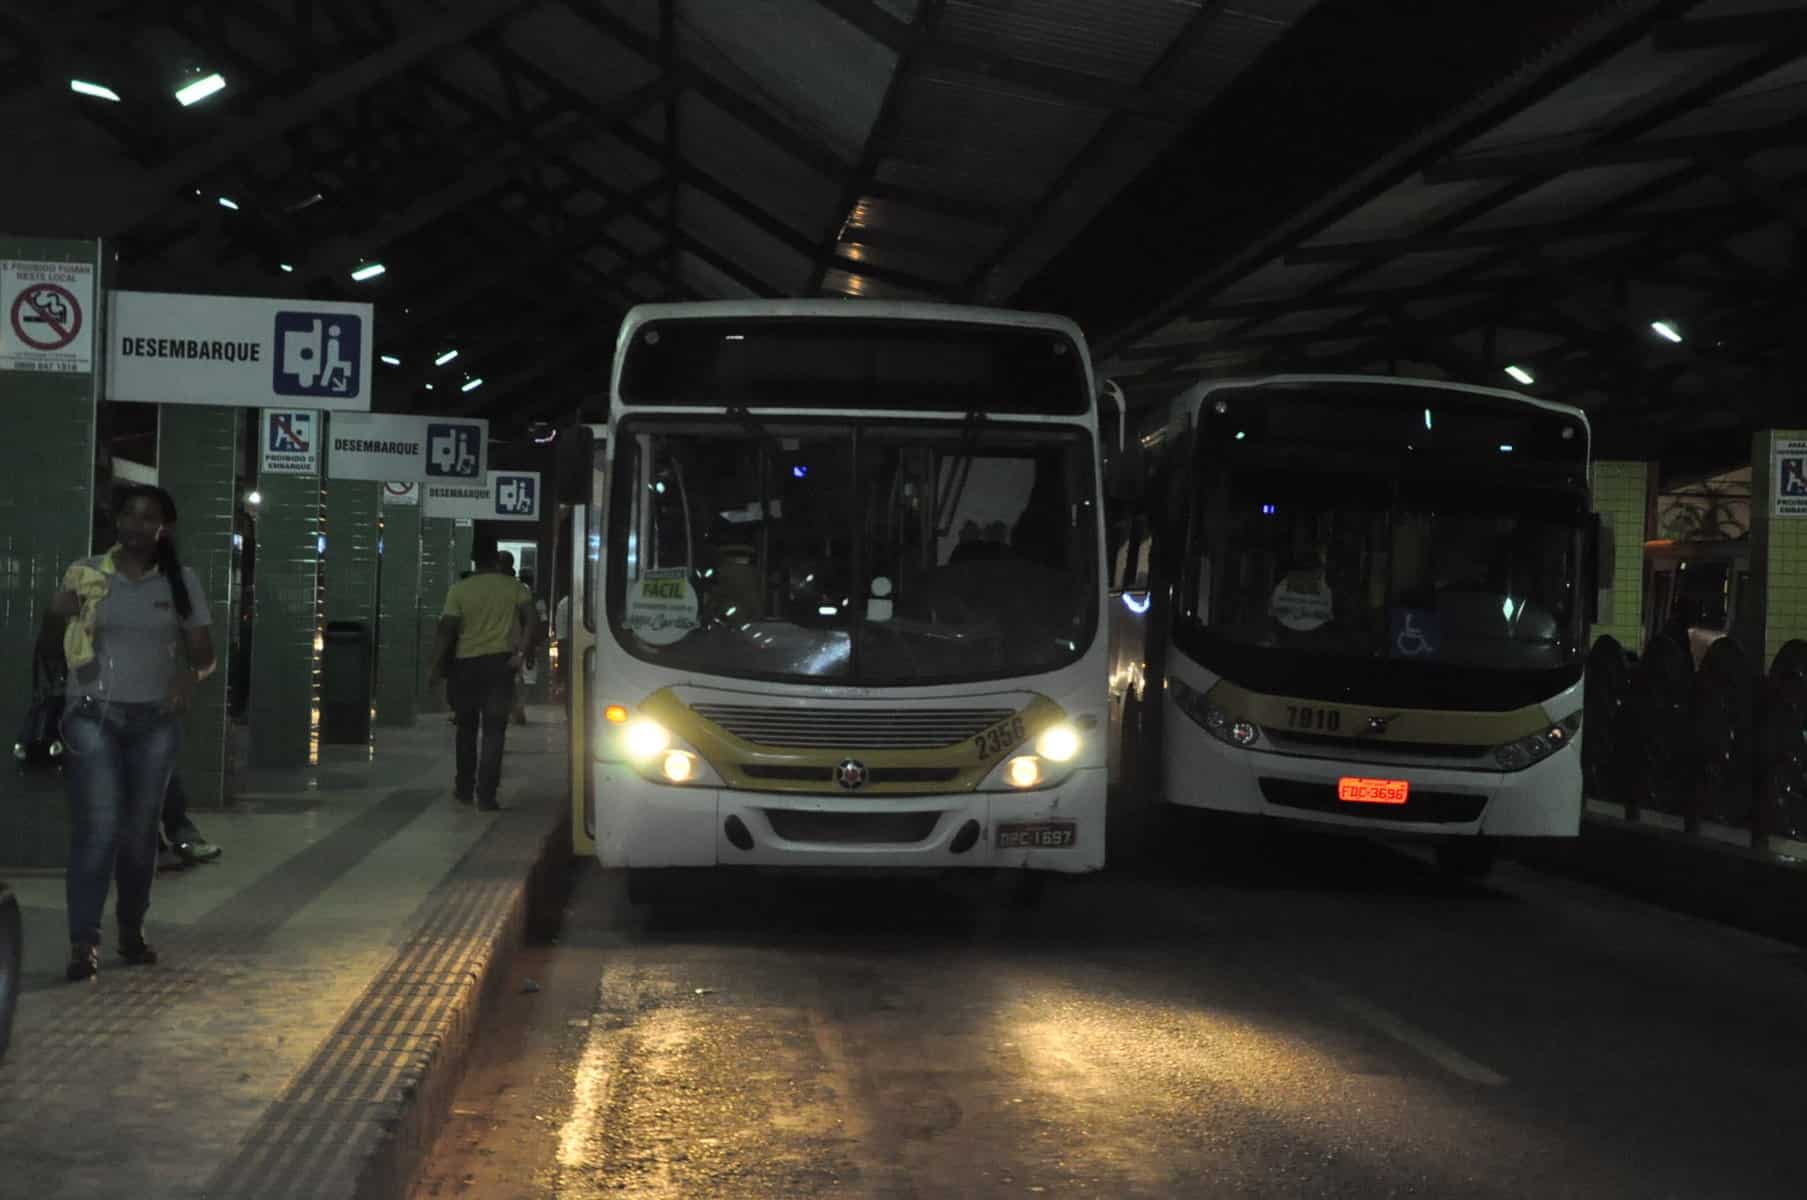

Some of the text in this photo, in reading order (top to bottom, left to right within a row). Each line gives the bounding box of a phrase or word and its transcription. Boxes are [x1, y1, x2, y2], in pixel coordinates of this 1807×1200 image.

[16, 271, 77, 282] NESTE LOCAL
[122, 337, 261, 362] DESEMBARQUE
[335, 439, 419, 456] DESEMBARQUE
[268, 463, 313, 471] EMBARQUE
[429, 487, 490, 500] DESEMBARQUE
